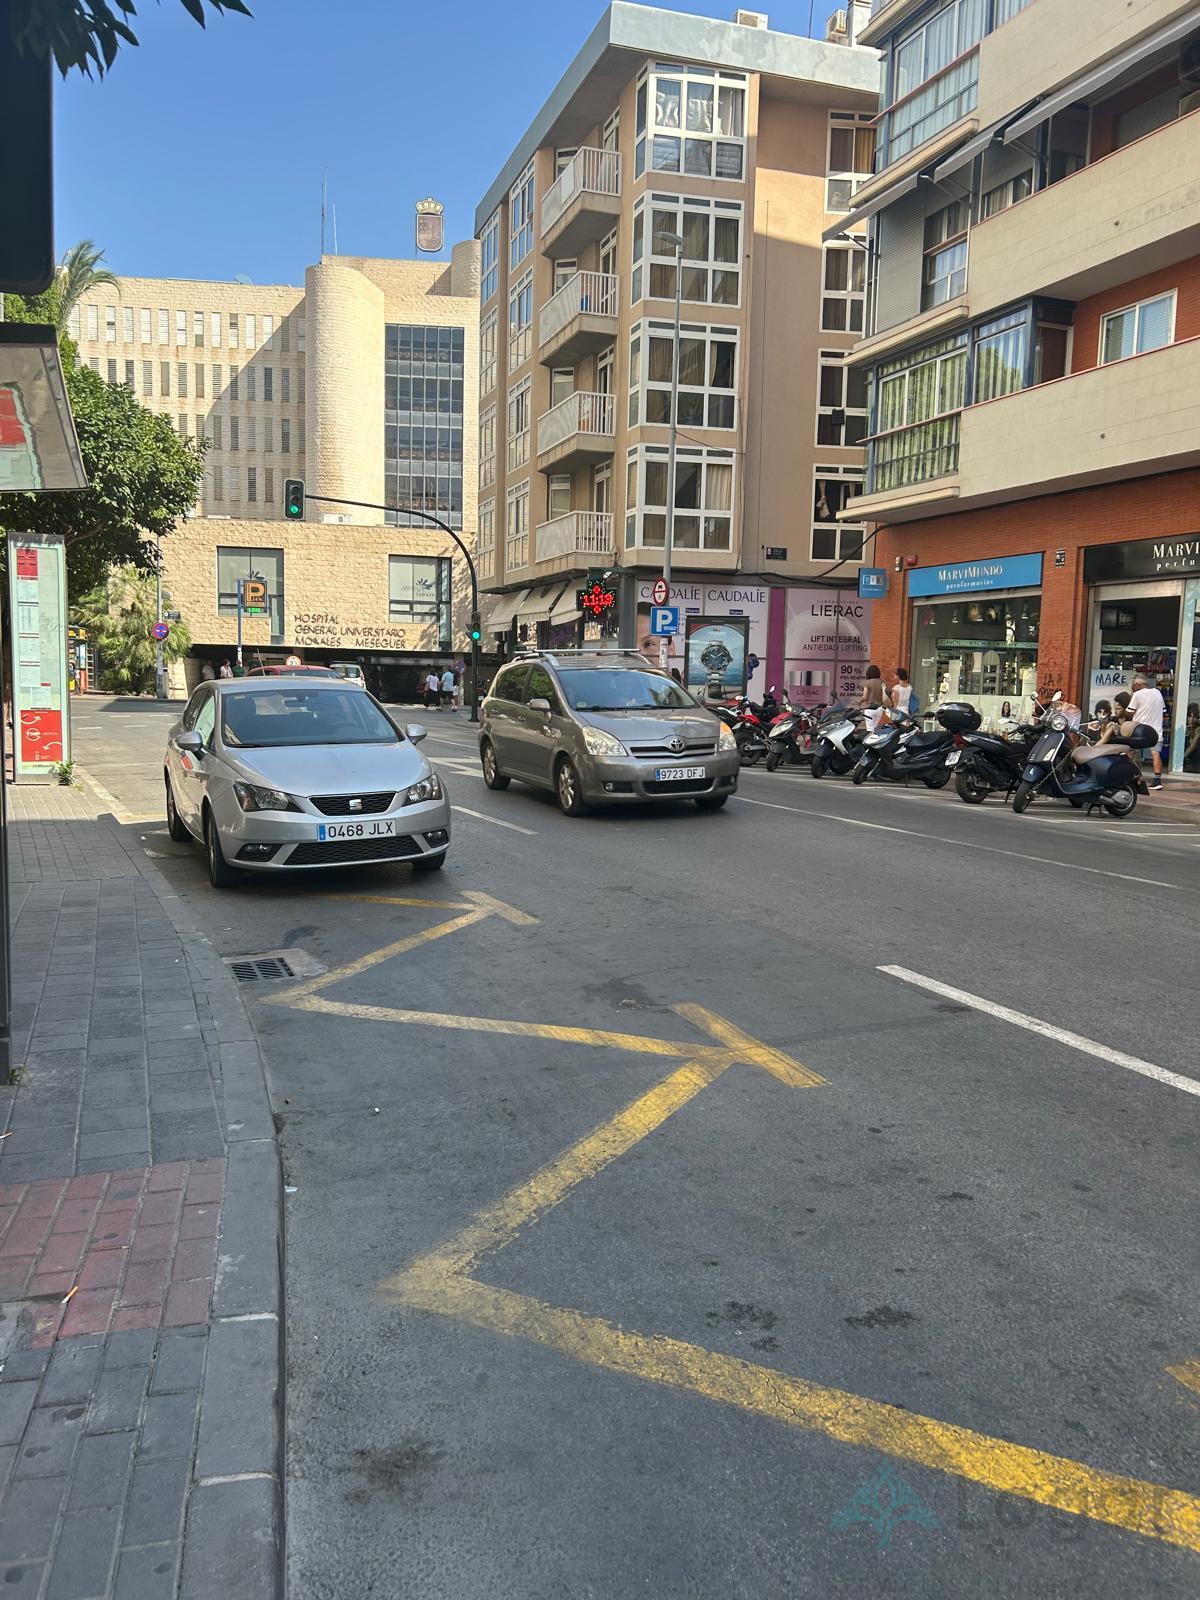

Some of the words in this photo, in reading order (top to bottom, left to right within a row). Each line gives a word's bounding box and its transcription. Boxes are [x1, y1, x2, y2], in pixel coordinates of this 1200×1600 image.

[811, 604, 864, 618] LIERAC
[294, 614, 340, 625] HOSPITAL
[656, 609, 673, 632] P
[294, 624, 337, 636] GENERAL
[340, 626, 406, 638] UNIVERSITARIO
[295, 636, 341, 647] MORALES
[355, 638, 406, 649] MESEGUER
[810, 635, 830, 643] LIFT
[831, 635, 862, 644] INTEGRAL
[841, 644, 868, 652] LIFTING
[840, 665, 853, 674] 90
[840, 682, 856, 691] -39
[661, 769, 684, 780] 9723
[687, 768, 704, 778] DFJ
[328, 824, 363, 838] 0468
[369, 821, 393, 836] JLX
